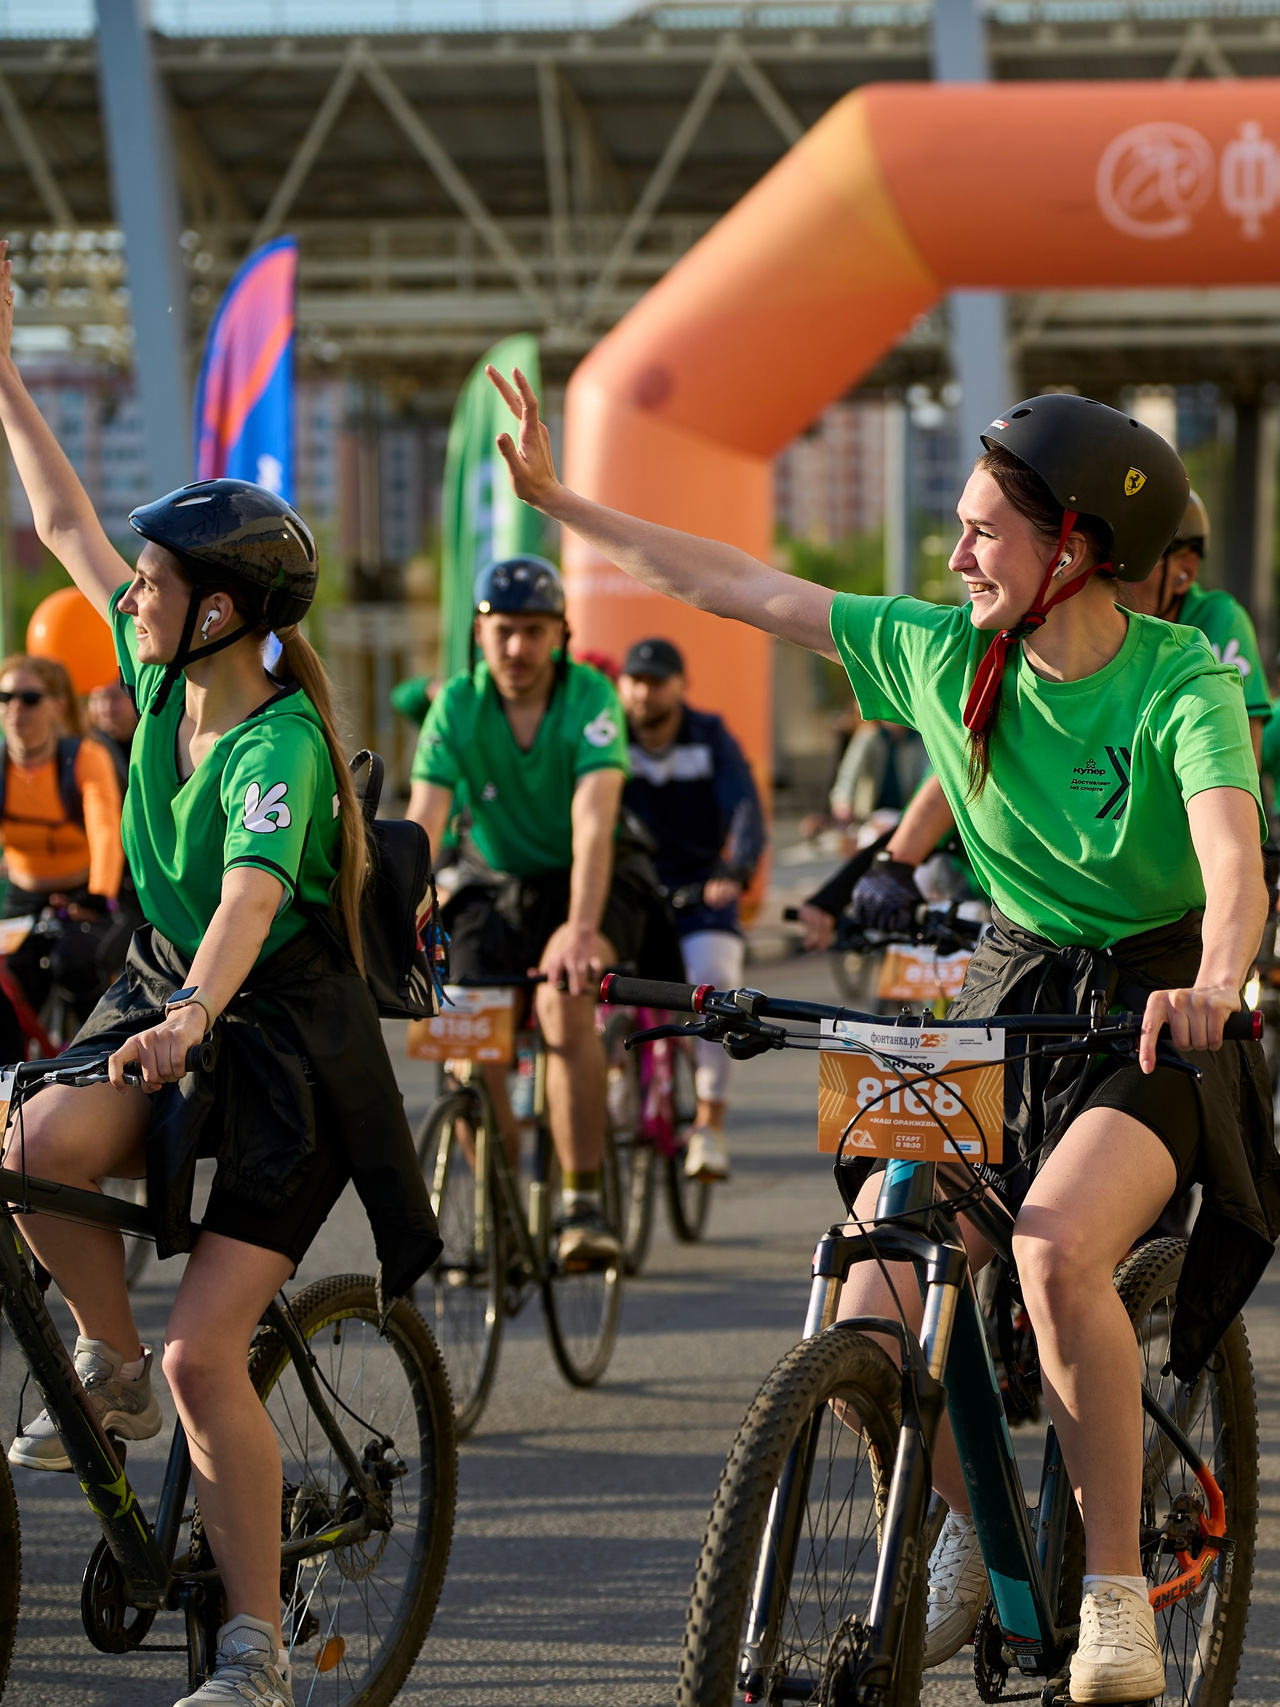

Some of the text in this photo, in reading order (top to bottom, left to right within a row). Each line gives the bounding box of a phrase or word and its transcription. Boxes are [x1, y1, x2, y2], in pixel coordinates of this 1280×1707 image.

[1073, 767, 1106, 776] купер
[870, 1031, 920, 1049] фонтанка.ру
[856, 1077, 963, 1117] 8168
[895, 1135, 921, 1143] СТАРТ
